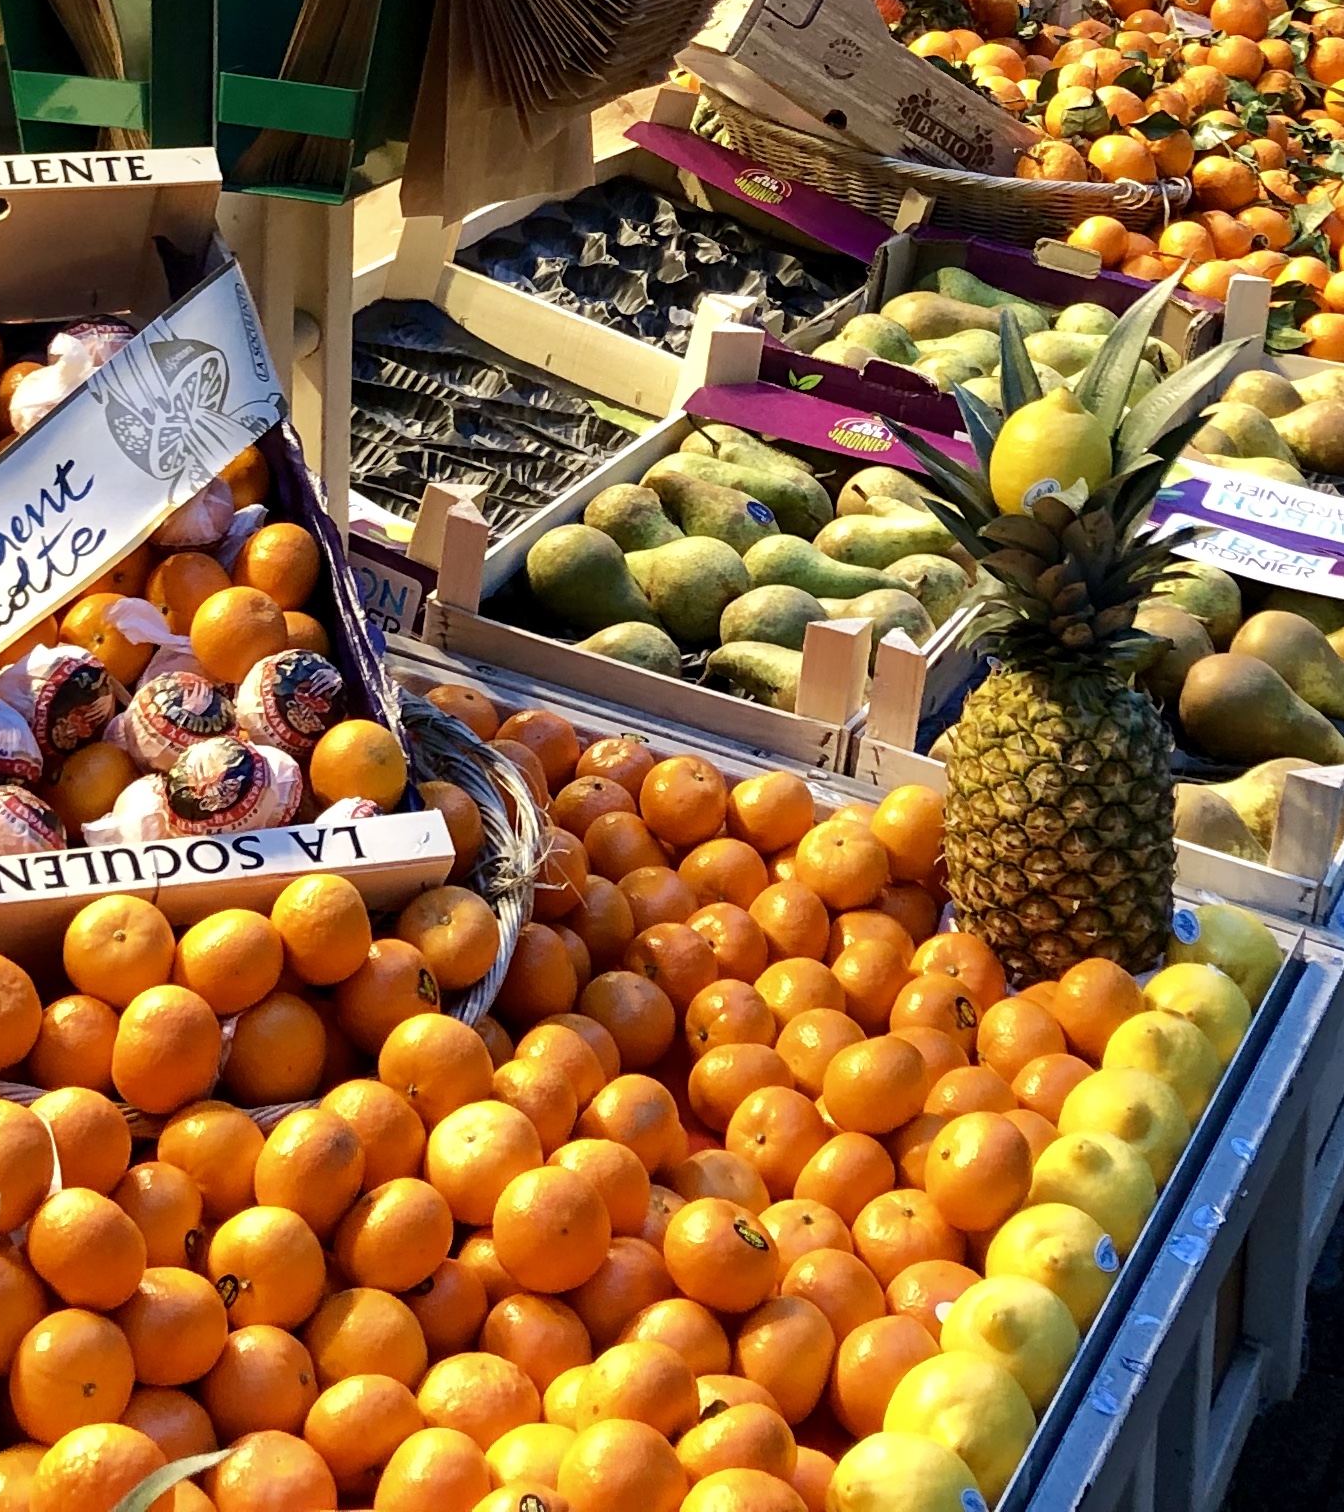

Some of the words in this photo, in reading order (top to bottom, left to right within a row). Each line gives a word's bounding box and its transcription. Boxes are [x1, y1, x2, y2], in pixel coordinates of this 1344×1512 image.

[916, 116, 969, 159] BRIO
[733, 176, 784, 205] JARDINIER
[827, 427, 893, 453] JARDINIER
[1186, 538, 1316, 579] ARDINIER
[285, 825, 367, 863] LA
